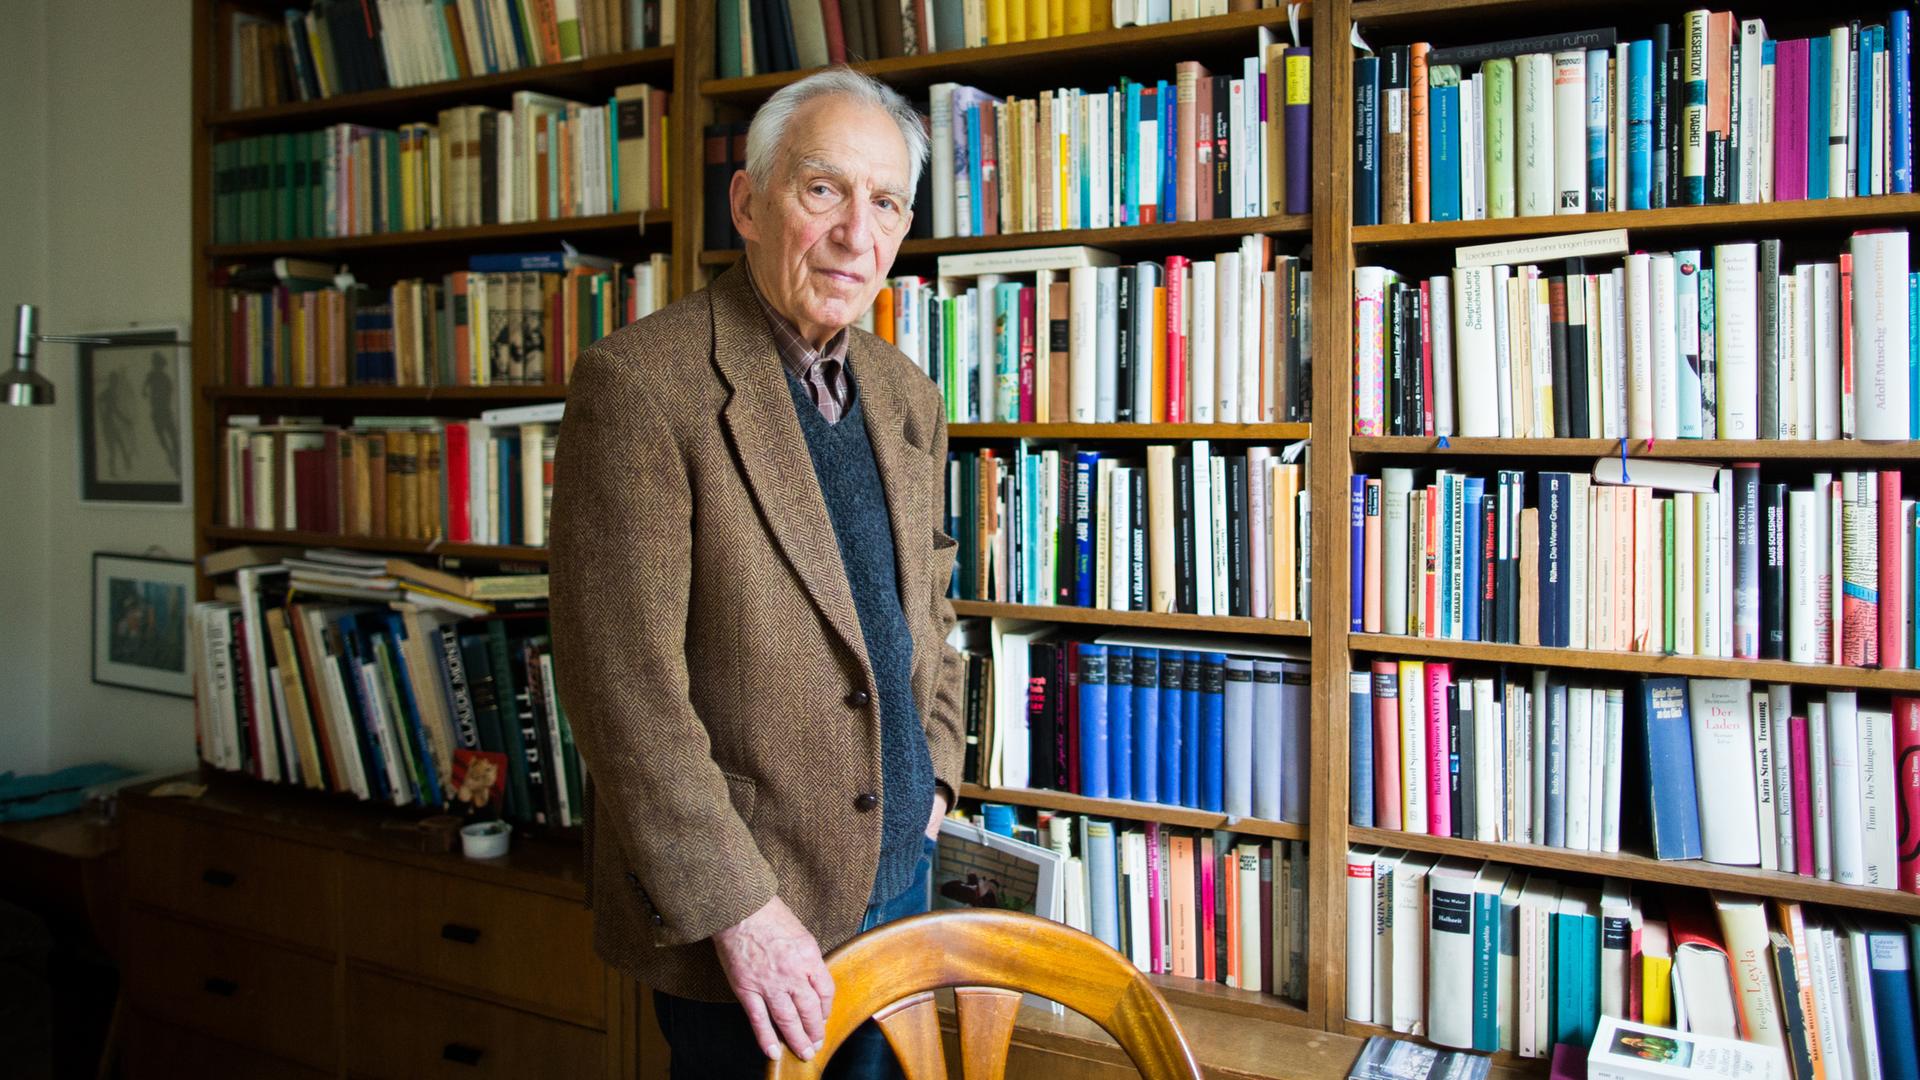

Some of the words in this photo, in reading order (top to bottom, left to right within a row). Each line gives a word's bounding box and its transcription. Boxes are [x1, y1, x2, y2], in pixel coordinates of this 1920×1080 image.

[1456, 46, 1492, 58] daniel
[1496, 36, 1559, 54] kehlmann
[1563, 33, 1599, 46] ruhm
[1691, 28, 1702, 77] KIESERITZKY
[1289, 58, 1298, 78] Roth
[1289, 79, 1298, 102] Philip
[1364, 85, 1372, 112] FEINDEN
[1364, 113, 1372, 125] DEN
[1364, 126, 1372, 138] VON
[1364, 139, 1372, 170] ABSCHIED
[1744, 147, 1754, 166] Kluge
[1744, 168, 1754, 200] Alexander
[1558, 242, 1582, 253] langen
[1584, 236, 1621, 250] Erinnerung
[1874, 240, 1884, 274] Ritter
[1766, 244, 1775, 284] herzzero
[1474, 270, 1482, 330] Deutschstunde
[1874, 276, 1884, 298] Rote
[1466, 292, 1474, 327] Siegfried
[1766, 292, 1775, 312] mon
[1874, 300, 1884, 322] Der
[1636, 320, 1644, 352] MARON
[1766, 314, 1775, 336] franz
[1874, 328, 1886, 376] Muschg
[1636, 356, 1644, 392] MONIKA
[1874, 378, 1886, 410] Adolf
[1780, 422, 1788, 434] dtv
[1077, 473, 1090, 520] BEAUTIFUL
[1454, 481, 1462, 520] KRANKHEIT
[1550, 494, 1559, 520] Gruppe
[1748, 482, 1756, 508] LEBST!
[1454, 520, 1462, 534] ZUR
[1738, 504, 1746, 530] FROH,
[1748, 510, 1756, 520] DU
[1768, 506, 1776, 546] SCHLESINGER
[1077, 523, 1090, 542] DAY
[1454, 535, 1462, 554] WILLE
[1486, 512, 1494, 558] Wäldernacht
[1550, 521, 1559, 546] Wiener
[1738, 532, 1746, 544] SEI
[1748, 524, 1756, 544] DASS
[1454, 556, 1462, 570] DER
[1550, 547, 1559, 560] Die
[1768, 547, 1776, 566] KLAUS
[1800, 550, 1808, 575] Schlink
[1454, 573, 1462, 590] ROTH
[1486, 562, 1494, 600] Rothmann
[1550, 562, 1559, 582] Rühm
[1800, 576, 1808, 606] Bernhard
[1814, 574, 1832, 627] Sartoris
[1454, 592, 1462, 624] GERHARD
[442, 631, 466, 683] MONET
[1814, 632, 1832, 661] Frau
[1408, 670, 1417, 703] Samstag
[457, 690, 477, 748] CLAUDE
[1409, 706, 1418, 731] Langer
[1552, 694, 1560, 725] Passanten
[1712, 706, 1732, 717] Der
[1758, 702, 1768, 743] Trennung
[1704, 719, 1740, 730] Laden
[1410, 733, 1418, 766] Spinnen
[1434, 726, 1442, 757] Spinnen
[1864, 716, 1876, 783] Schlangenbaum
[1552, 752, 1560, 774] Strauß
[1760, 748, 1769, 776] Struck
[1912, 756, 1920, 772] Timm
[1410, 768, 1418, 806] Burkhard
[1434, 760, 1442, 796] Burkhard
[1552, 775, 1560, 795] Botho
[1761, 778, 1770, 804] Karin
[1778, 765, 1788, 792] Struck
[1912, 772, 1920, 786] Uwe
[1780, 792, 1790, 816] Karin
[1866, 784, 1875, 800] Der
[1866, 806, 1876, 832] Timm
[1377, 864, 1385, 898] WALSER
[1377, 902, 1385, 937] MARTIN
[1385, 904, 1394, 928] Ohne
[1438, 914, 1462, 924] Halbzeit
[1740, 949, 1762, 993] Leyla
[1797, 959, 1811, 987] NAH
[1830, 954, 1839, 984] Widmer
[1756, 997, 1768, 1030] Feridun
[1804, 991, 1814, 1030] WELLERSHOFF
[1823, 1016, 1832, 1042] Widmer
[1810, 1032, 1820, 1061] MARIANNE
